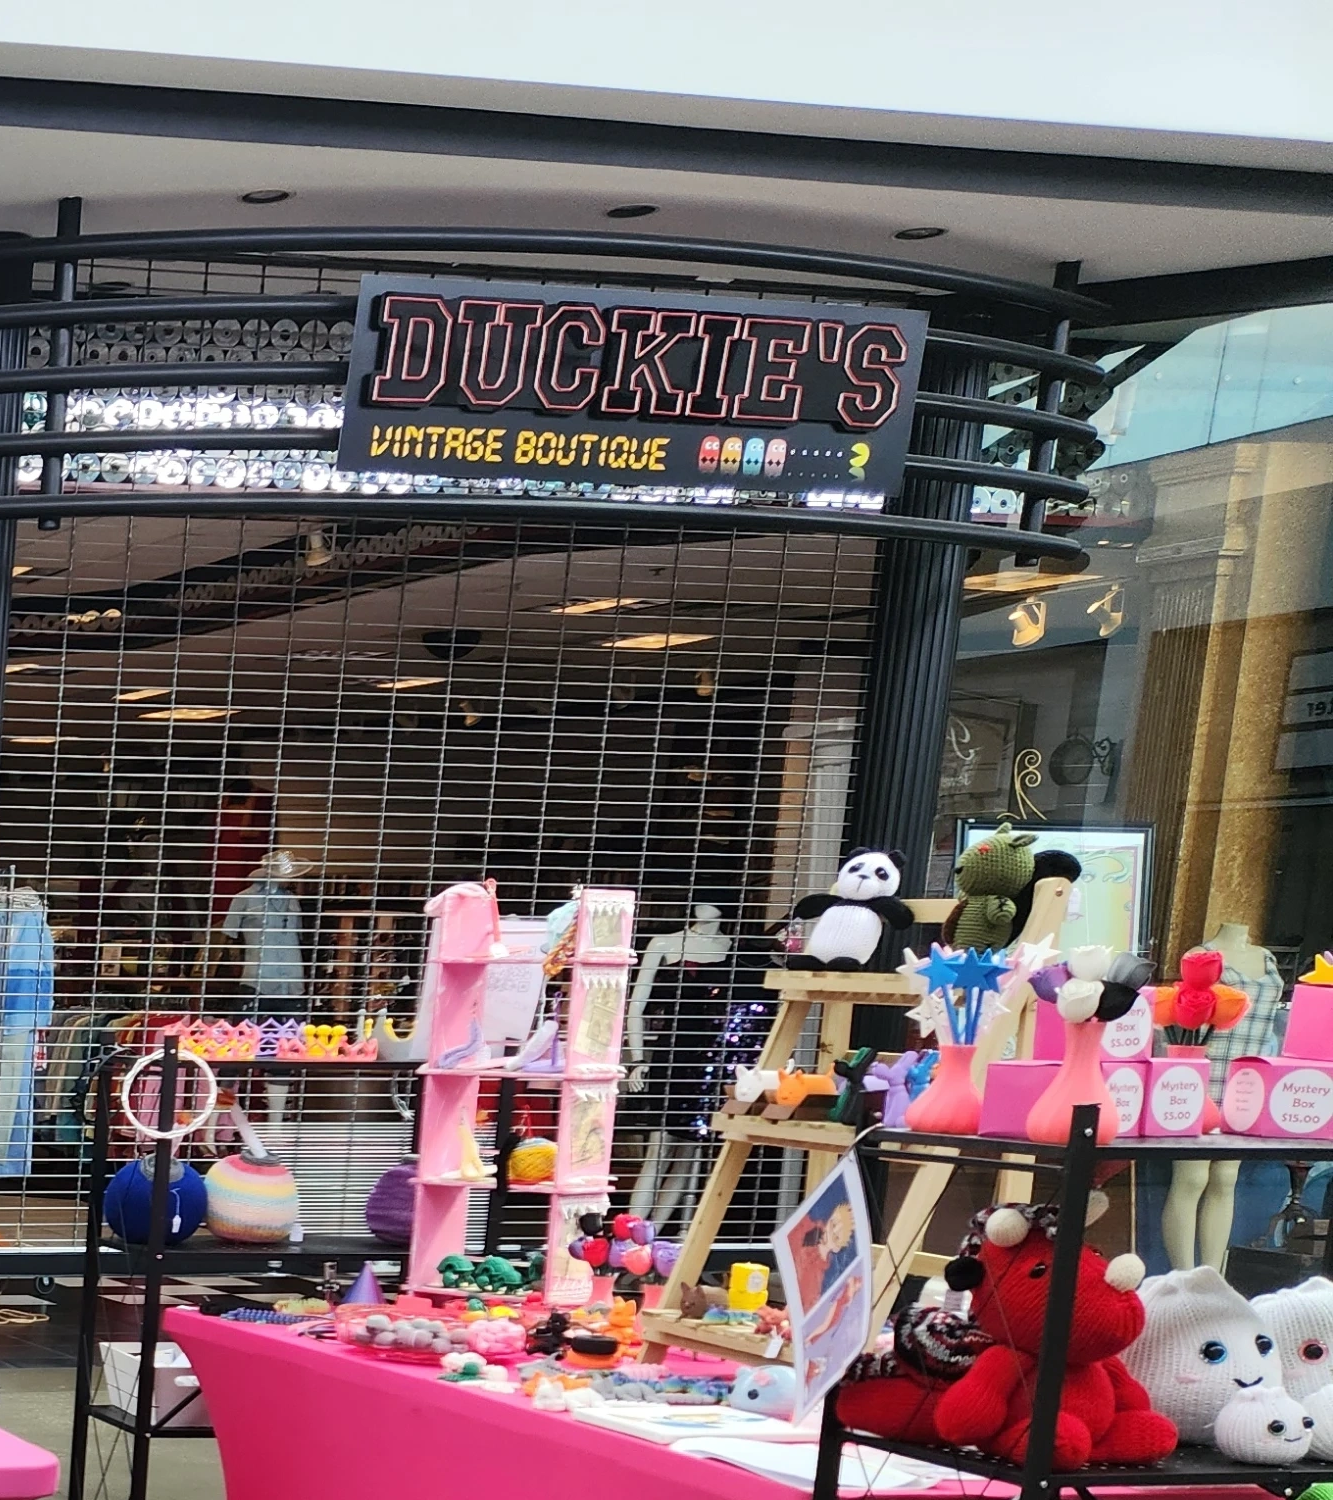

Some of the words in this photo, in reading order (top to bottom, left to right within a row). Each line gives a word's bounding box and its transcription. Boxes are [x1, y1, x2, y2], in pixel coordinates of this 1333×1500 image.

[367, 293, 910, 430] DUCKIE'S
[370, 425, 507, 463] VINTAGE
[514, 432, 670, 471] BOUTIQUE
[1116, 1023, 1135, 1032] Box
[1161, 1081, 1198, 1091] Mystery
[1282, 1082, 1330, 1096] Mystery
[1169, 1096, 1187, 1105] Box
[1292, 1098, 1315, 1108] Box
[1282, 1113, 1320, 1124] $15.00
